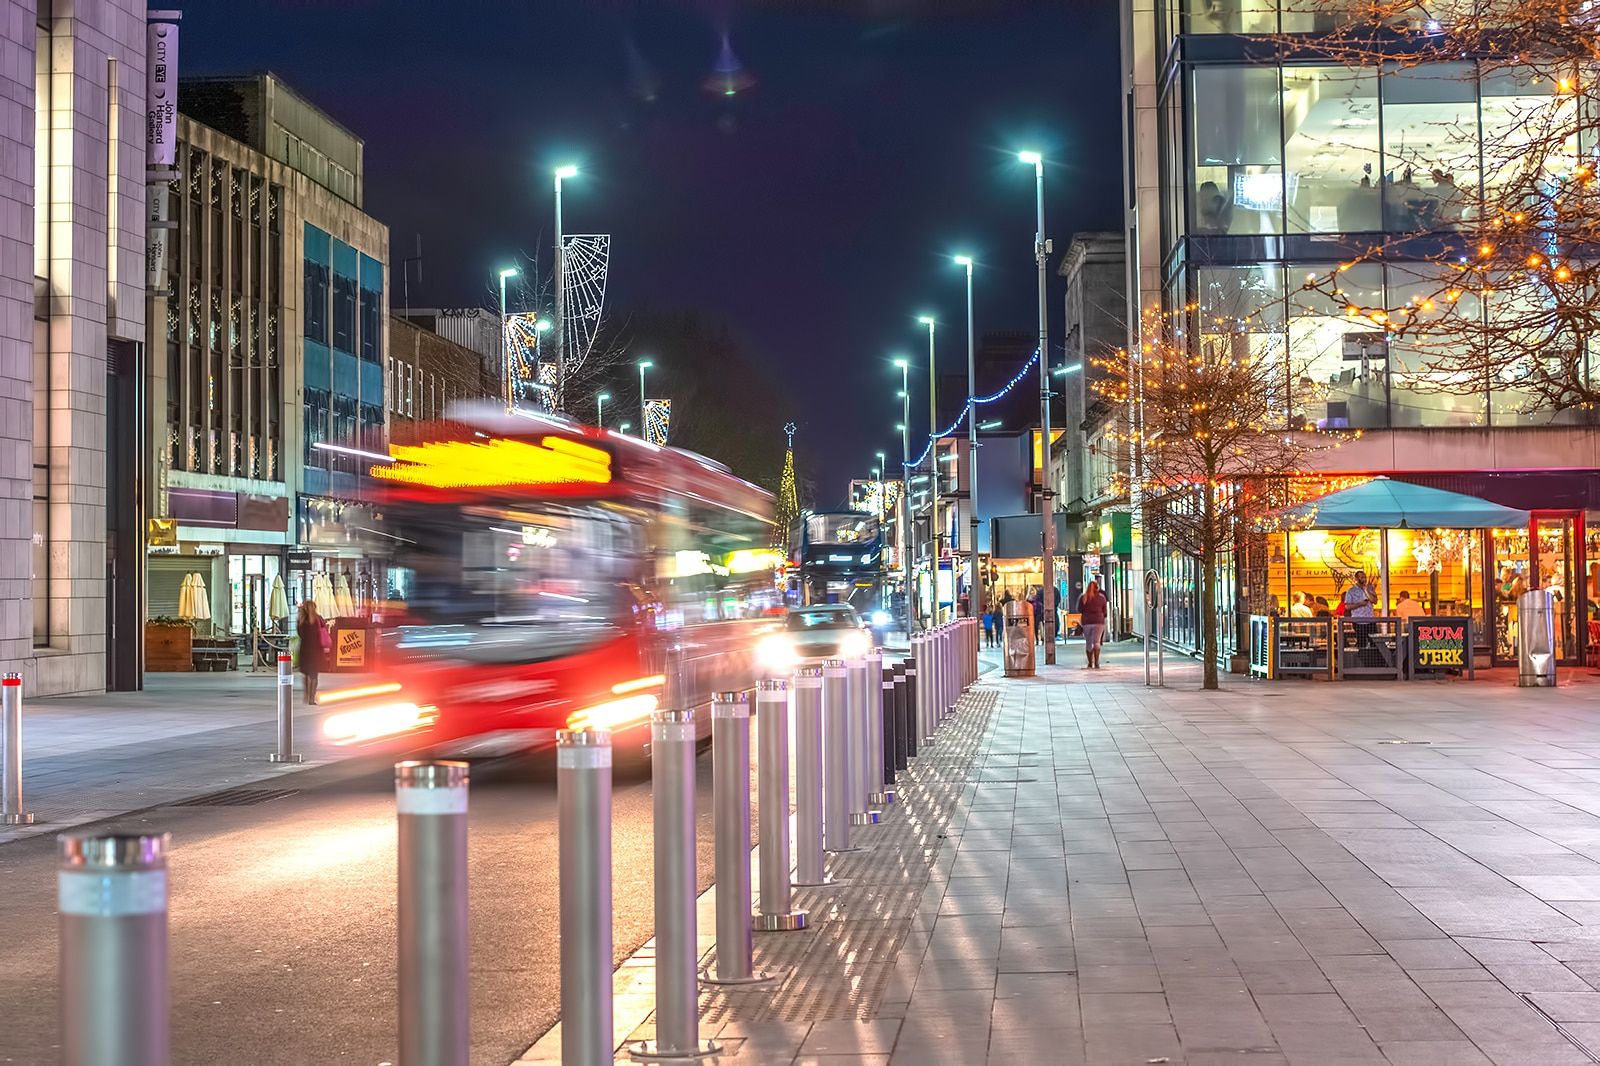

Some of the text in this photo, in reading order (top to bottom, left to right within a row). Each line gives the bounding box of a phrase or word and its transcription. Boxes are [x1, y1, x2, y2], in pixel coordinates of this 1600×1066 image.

[155, 41, 166, 82] CITY EYE
[165, 101, 174, 124] John
[148, 111, 156, 145] Gallery
[156, 105, 164, 144] Hansard
[343, 631, 359, 643] LIVE
[1418, 626, 1464, 639] RUM
[1419, 649, 1463, 665] JERK
